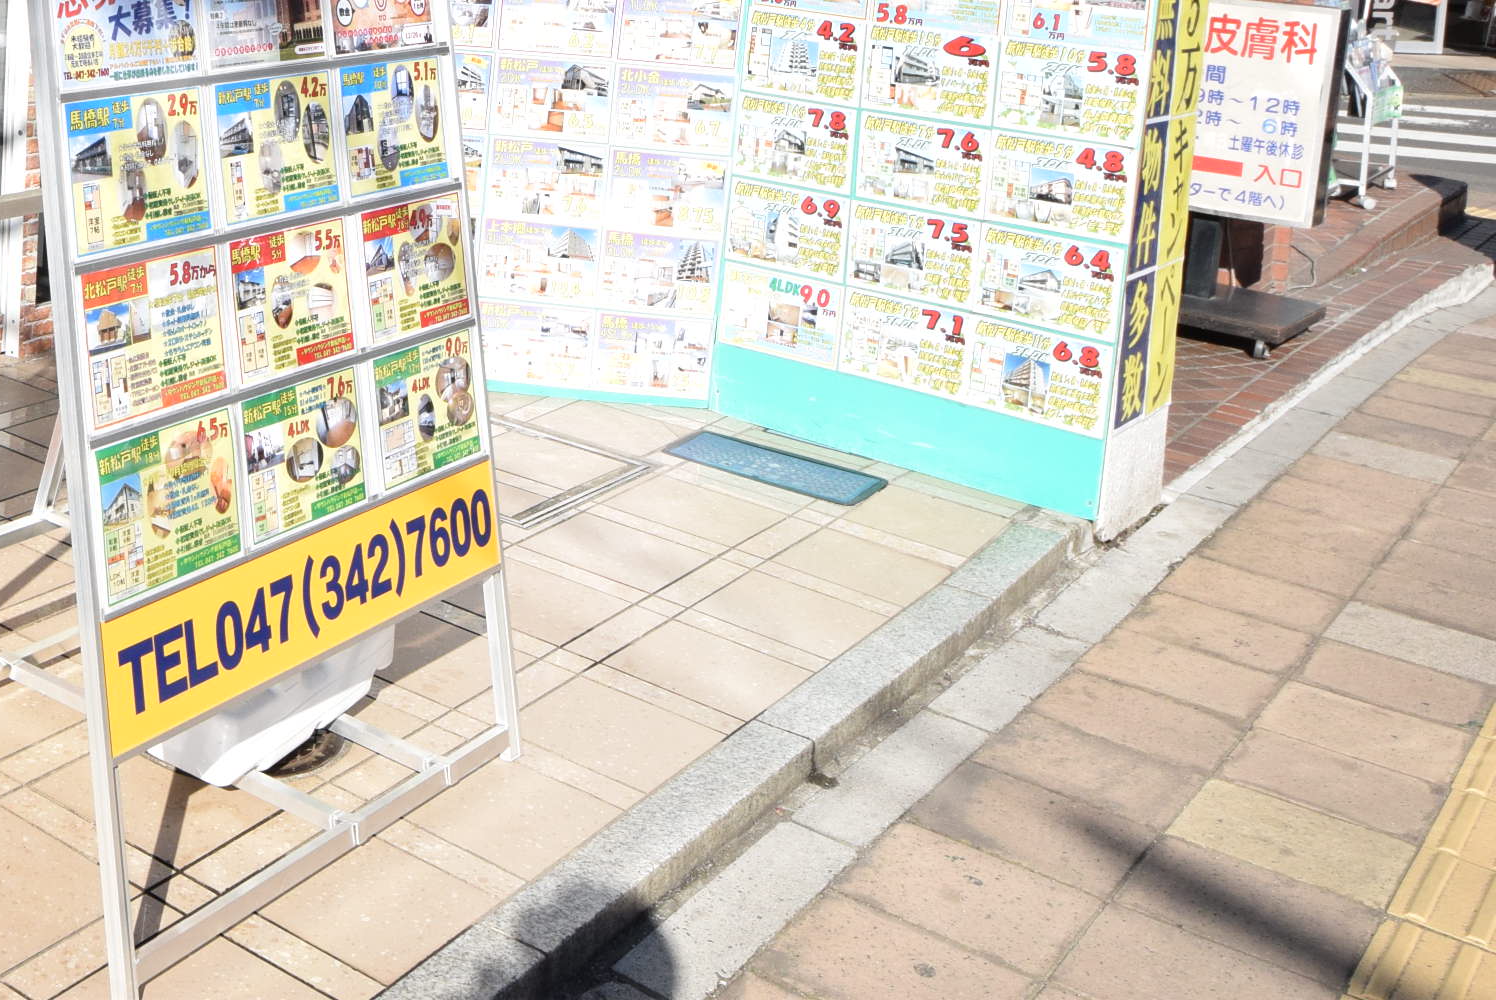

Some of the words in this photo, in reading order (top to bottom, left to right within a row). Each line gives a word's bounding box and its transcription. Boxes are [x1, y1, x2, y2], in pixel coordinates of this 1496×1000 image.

[875, 1, 924, 26] 5.8万円
[1032, 12, 1061, 32] 6.1
[816, 20, 856, 43] 4.2
[1047, 31, 1065, 41] 万円
[1204, 13, 1319, 66] 皮膚科
[942, 35, 988, 58] 6
[413, 61, 437, 82] 5.1万
[499, 59, 540, 74] 新松戸
[1087, 50, 1137, 77] 5.8
[300, 77, 327, 98] 4.2万
[621, 69, 660, 85] 北小金
[70, 106, 110, 131] 馬橋駅
[112, 101, 131, 115] 徒歩
[167, 93, 198, 117] 2.9万
[808, 107, 847, 132] 7.8
[936, 127, 980, 153] 7.6
[1227, 135, 1305, 161] 土曜午後休診
[1075, 147, 1125, 173] 4.8
[1253, 164, 1303, 189] 入口
[800, 195, 841, 219] 6.9
[363, 213, 396, 234] 新松戸駅
[926, 218, 969, 243] 7.5
[231, 244, 261, 265] 馬橋駅
[269, 234, 285, 248] 徒歩
[314, 228, 341, 251] 5.5万
[1063, 244, 1112, 273] 6.4
[84, 277, 128, 300] 北松戸駅
[127, 266, 145, 281] 徒歩
[169, 260, 217, 287] 5.8万から
[768, 276, 801, 297] 4LDK
[799, 284, 831, 308] 9.0
[920, 308, 965, 337] 7.1
[444, 336, 469, 358] 9.0万
[1051, 340, 1101, 369] 6.8
[411, 376, 431, 393] 4LDK
[244, 400, 282, 425] 新松戸駅
[326, 375, 354, 403] 7.6万
[287, 418, 310, 439] 4LDK
[98, 449, 142, 475] 新松戸駅
[140, 435, 159, 452] 徒歩
[196, 417, 229, 443] 6.5万
